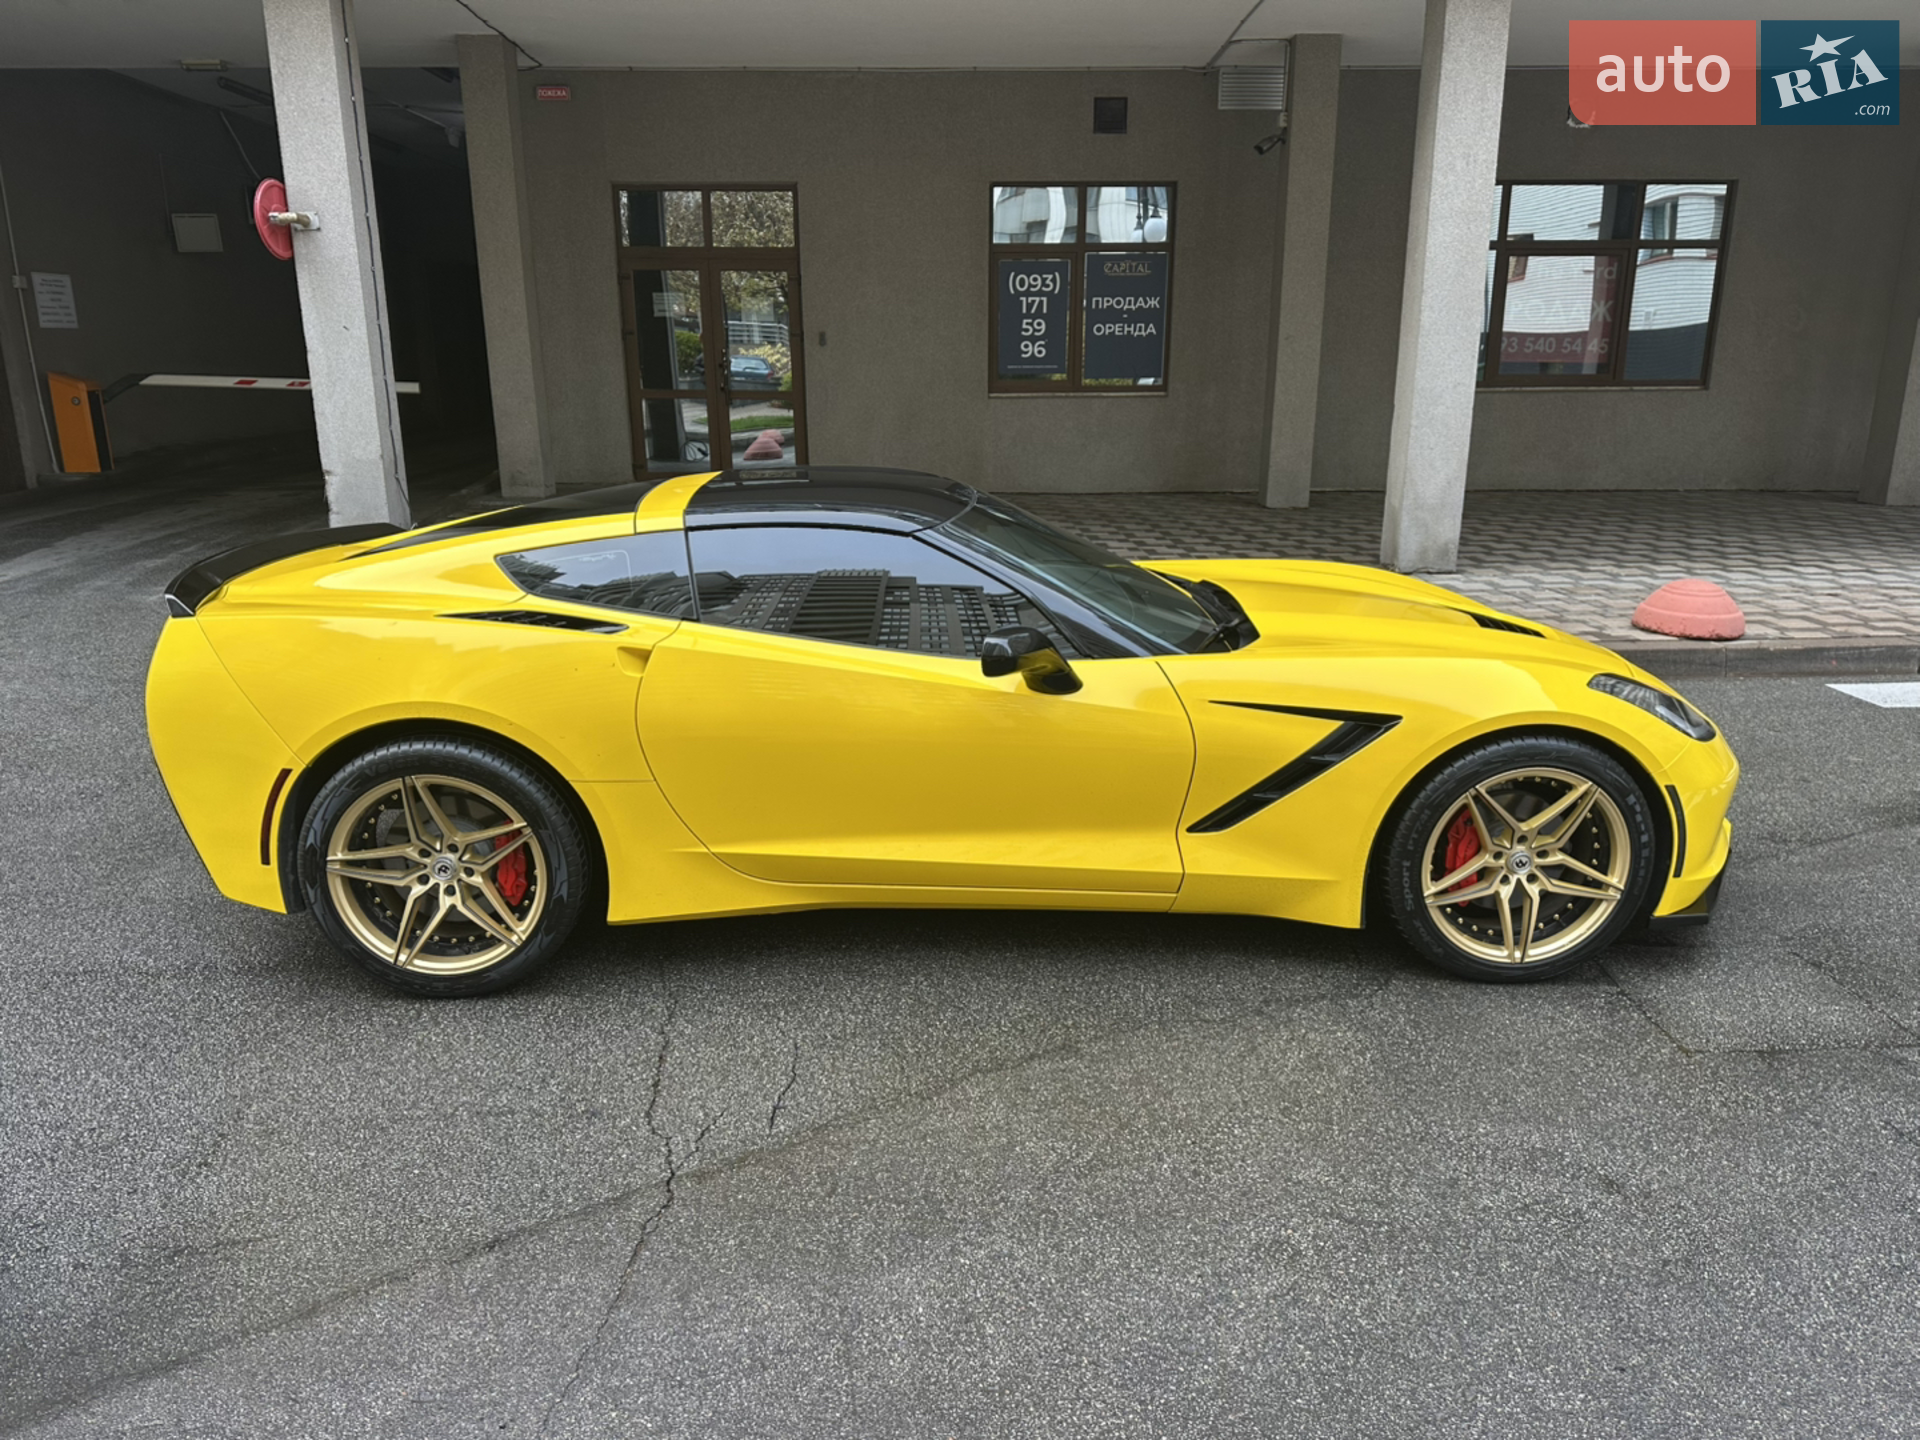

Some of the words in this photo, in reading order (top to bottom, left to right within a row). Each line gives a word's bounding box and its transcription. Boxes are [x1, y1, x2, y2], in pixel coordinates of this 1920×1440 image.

[1103, 261, 1152, 273] CAPITAL
[1008, 271, 1061, 294] (093)
[1019, 296, 1048, 314] 171
[1091, 296, 1161, 311] ПРОДАЖ
[1020, 318, 1047, 336] 59
[1092, 323, 1157, 337] ОРЕНДА
[1020, 340, 1047, 358] 96
[1523, 337, 1557, 353] 540
[1561, 337, 1582, 354] 54
[1587, 338, 1610, 354] 45
[1402, 860, 1415, 911] Sport
